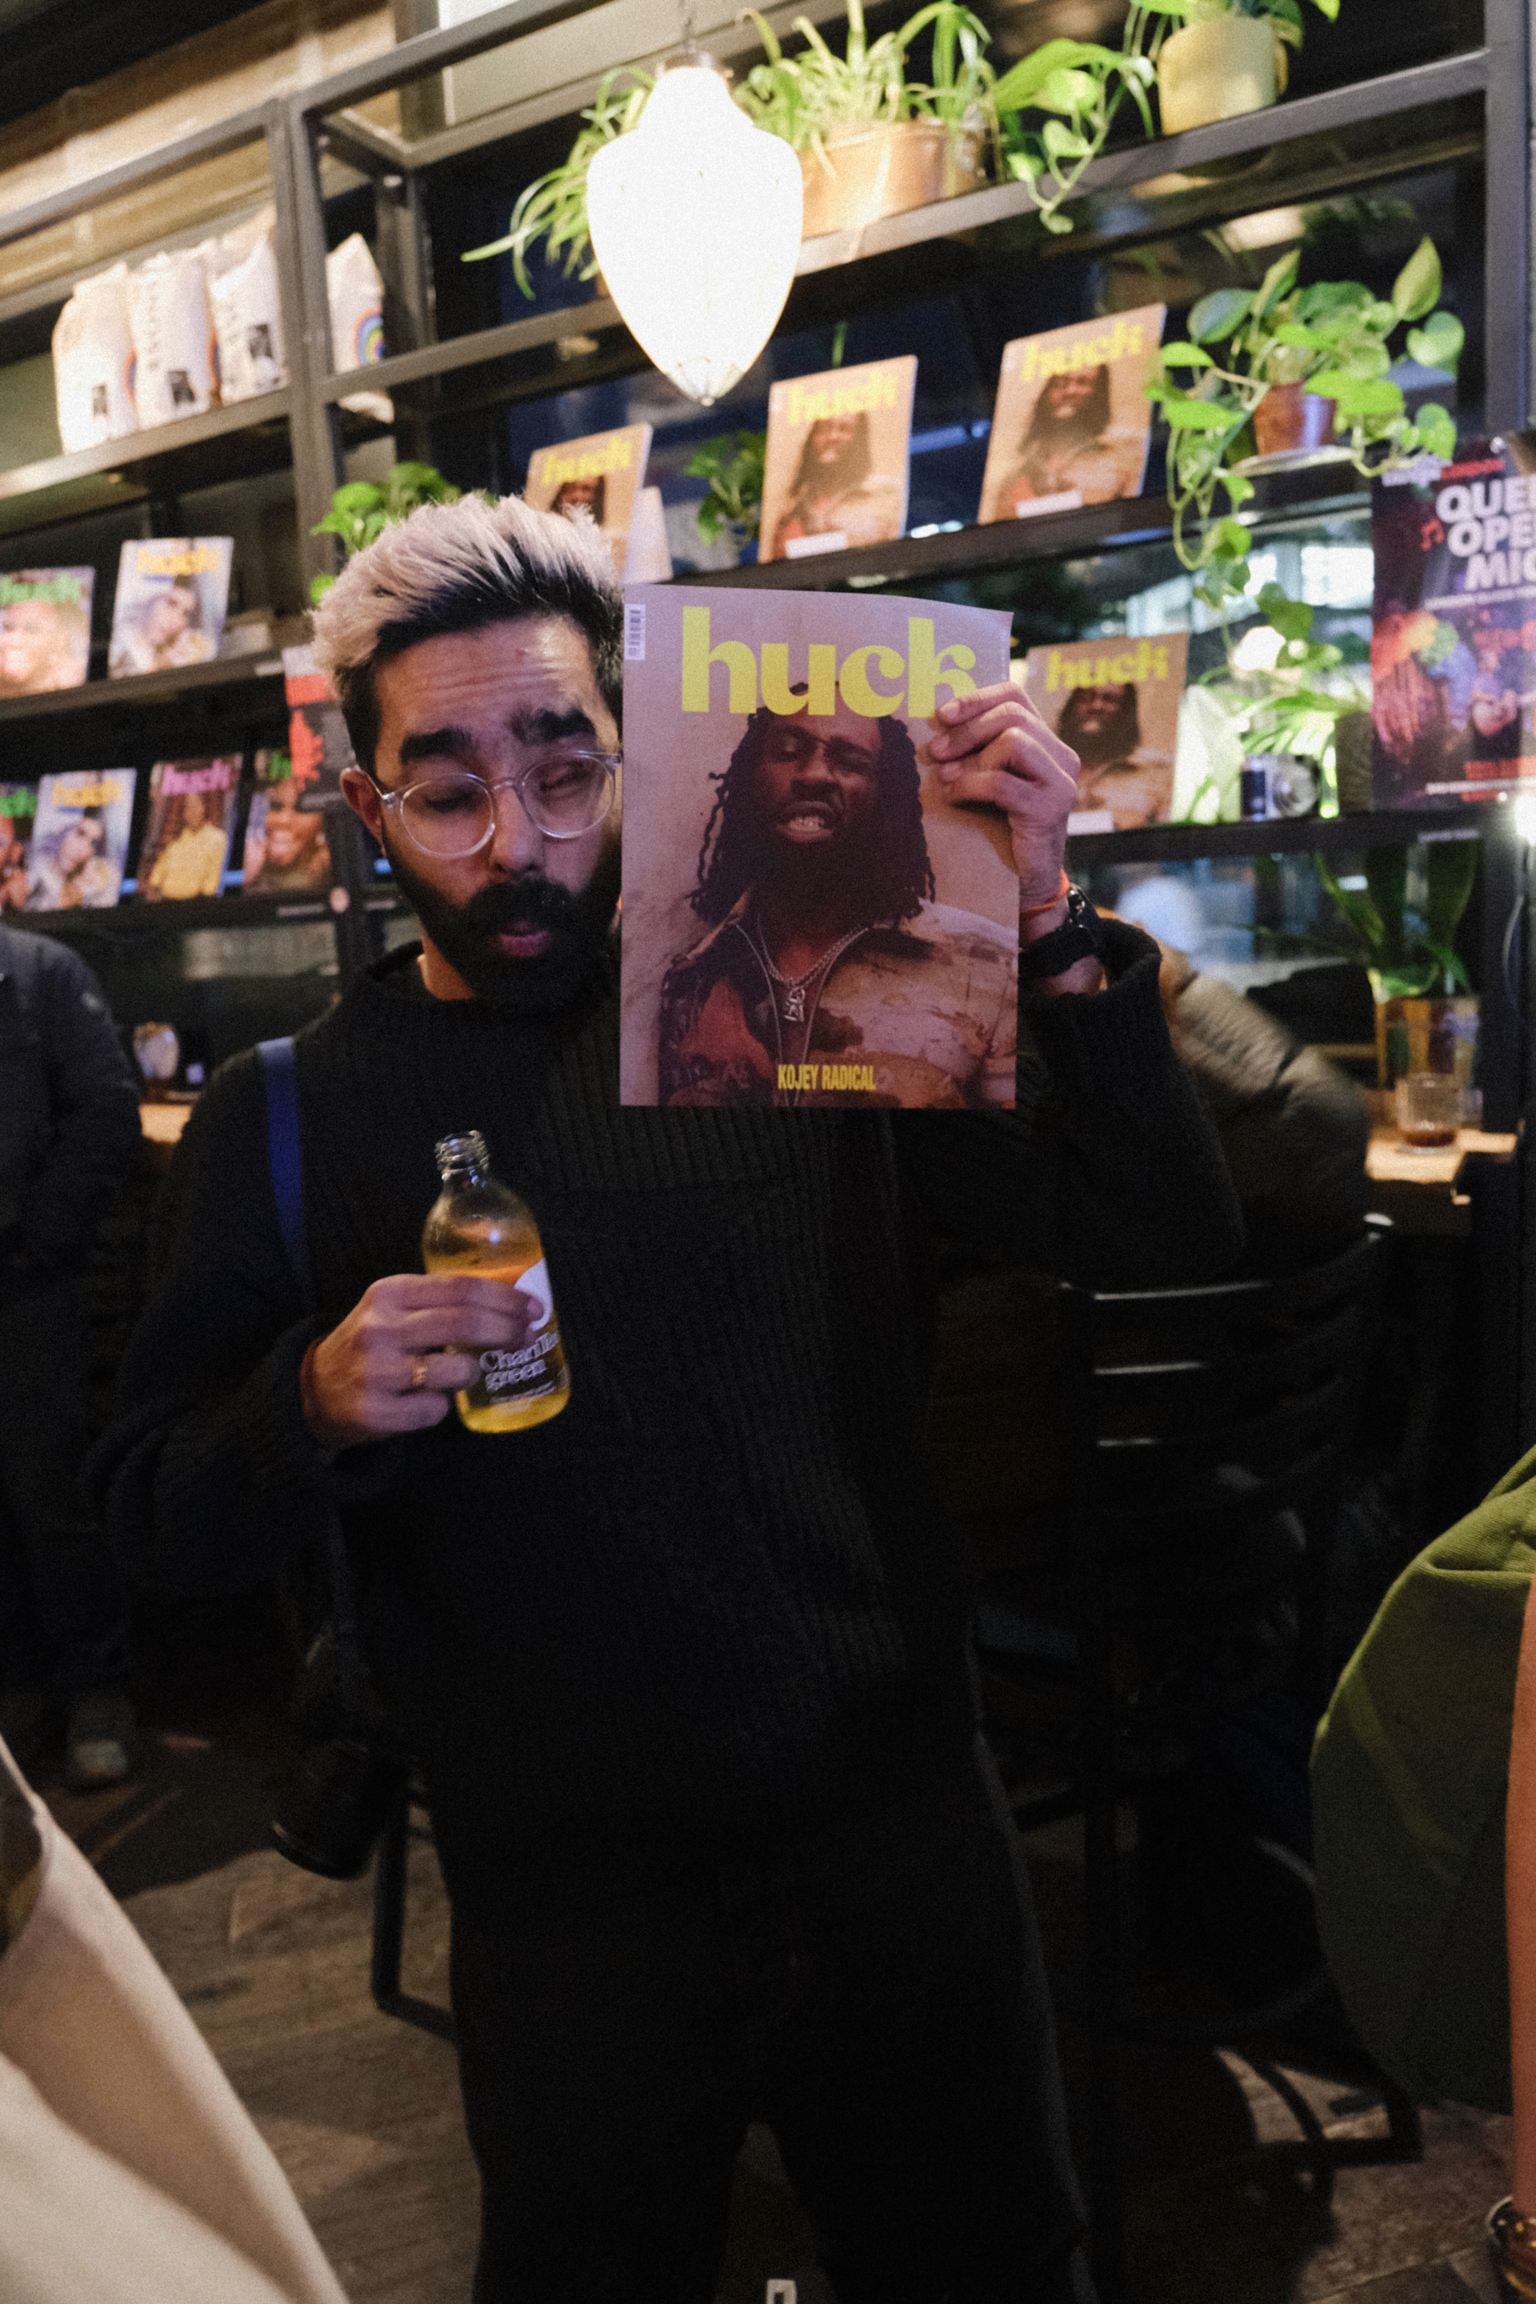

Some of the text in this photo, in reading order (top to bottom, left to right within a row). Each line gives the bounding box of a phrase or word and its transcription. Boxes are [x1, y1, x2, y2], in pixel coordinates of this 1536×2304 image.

[1436, 474, 1536, 524] QUE
[682, 606, 977, 718] huck
[1046, 641, 1168, 692] huck
[777, 1064, 876, 1091] KOJEY RADICAL
